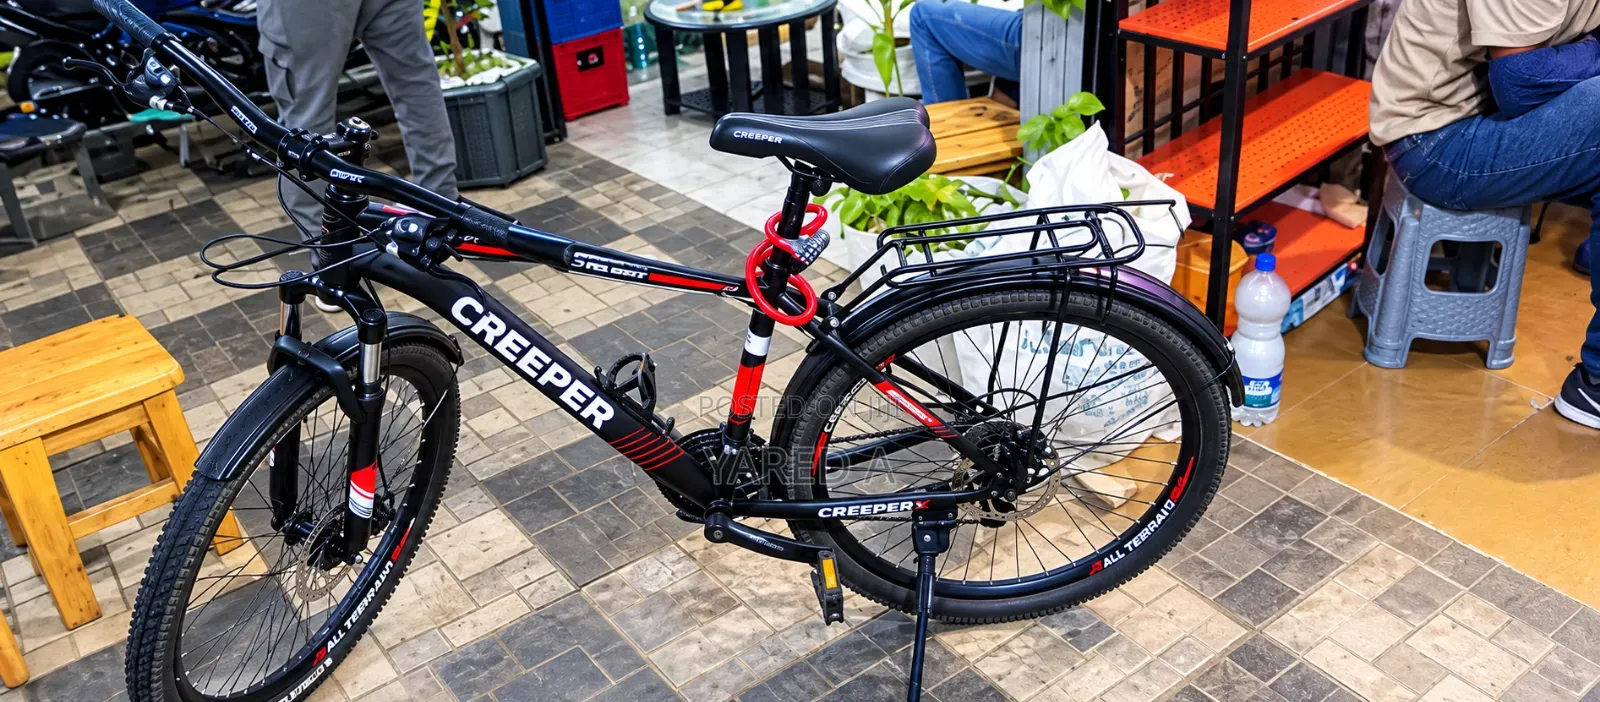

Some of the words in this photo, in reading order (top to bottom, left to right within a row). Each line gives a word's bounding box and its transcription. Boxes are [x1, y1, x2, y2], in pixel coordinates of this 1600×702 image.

[733, 130, 783, 144] CREEPER
[451, 296, 615, 430] CREEPER
[1103, 549, 1126, 568] ALL
[326, 630, 346, 653] ALL
